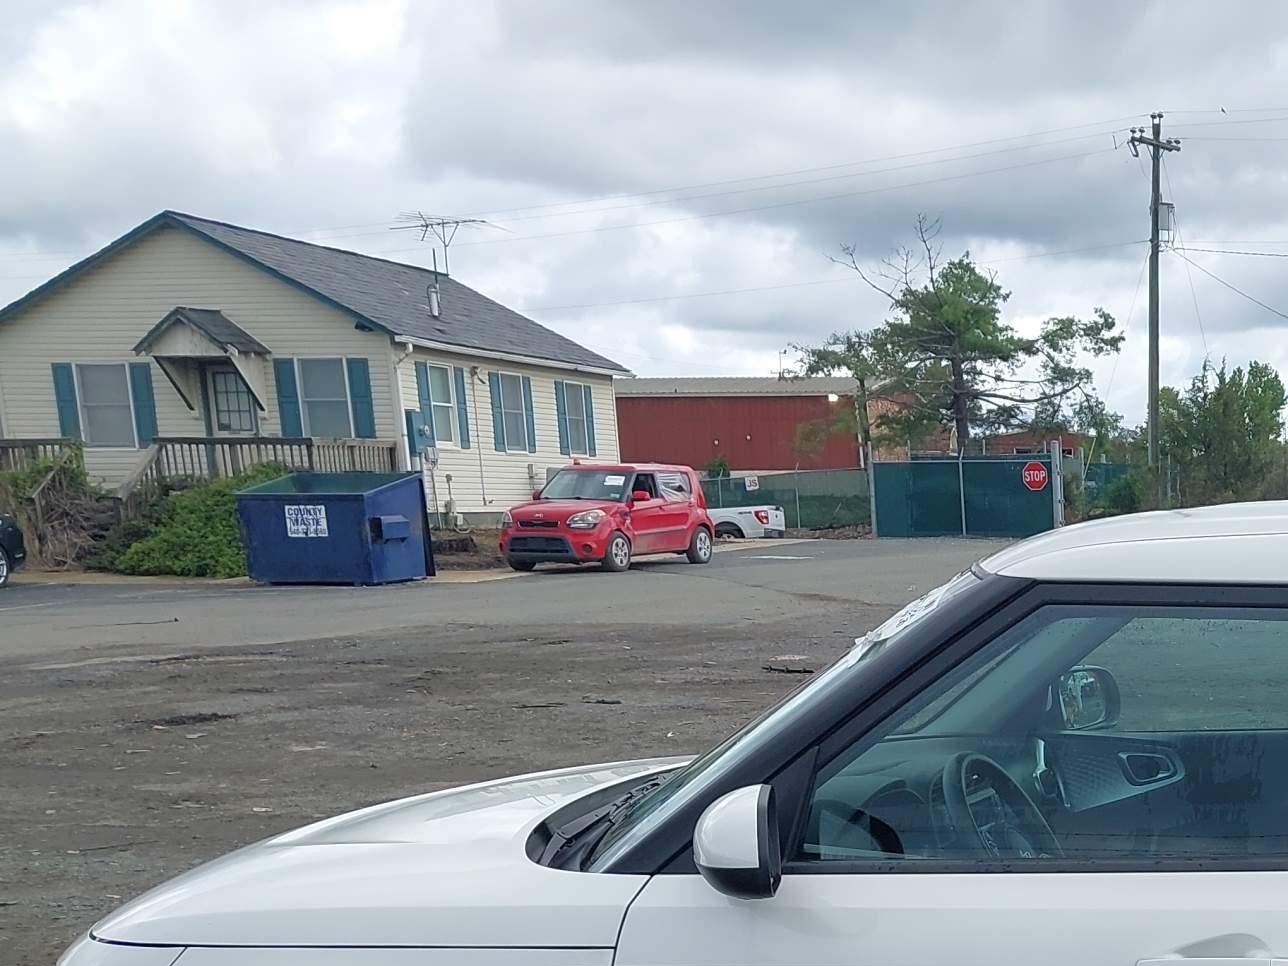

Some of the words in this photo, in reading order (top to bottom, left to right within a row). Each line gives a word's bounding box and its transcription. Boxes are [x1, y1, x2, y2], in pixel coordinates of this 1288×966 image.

[1024, 470, 1046, 482] STOP
[287, 507, 322, 516] COUNTY
[290, 517, 322, 526] WASTE
